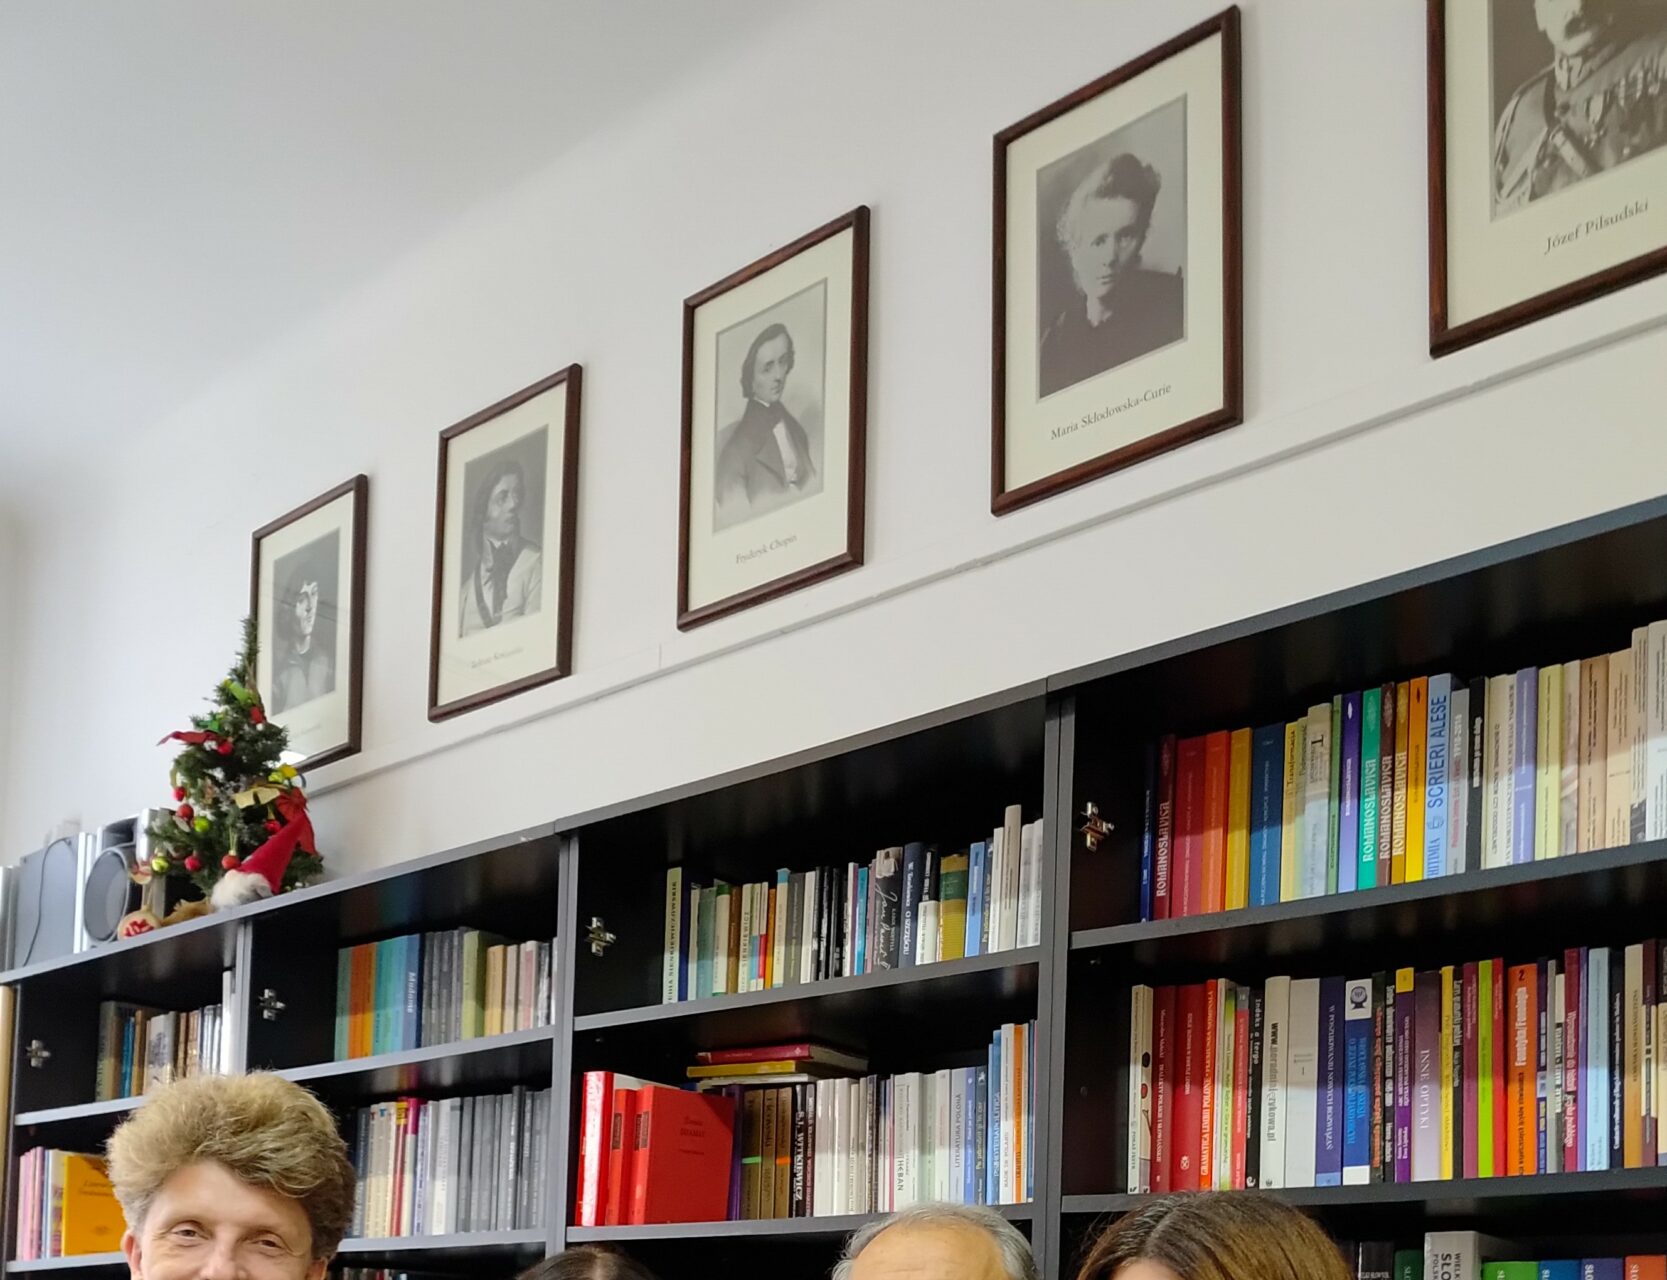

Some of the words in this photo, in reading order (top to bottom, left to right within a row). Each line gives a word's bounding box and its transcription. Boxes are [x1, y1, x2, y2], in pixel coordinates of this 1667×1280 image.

[1544, 223, 1582, 256] Józef
[1051, 422, 1079, 441] Maria
[769, 535, 798, 552] Chopin
[1429, 695, 1447, 738] ALESE
[1427, 743, 1445, 808] SCRIERI
[1363, 759, 1376, 862] ROMANOSLAVICA
[1379, 755, 1393, 859] ROMANOSLAVICA
[1392, 751, 1406, 855] ROMANOSLAVICA
[1156, 801, 1170, 897] ROMANOSLAVICA
[875, 884, 898, 919] Jan
[1517, 969, 1526, 981] 2
[1253, 998, 1262, 1028] Indeks
[1252, 1041, 1261, 1065] tergo
[1420, 1049, 1430, 1081] INNE
[1202, 1077, 1211, 1108] POLONE
[1419, 1085, 1430, 1129] OPTYKI
[1201, 1108, 1210, 1133] LIMBII
[795, 1132, 805, 1201] WITKIEWICZ
[1200, 1133, 1210, 1176] GRAMATICA
[896, 1160, 905, 1191] HEBAN
